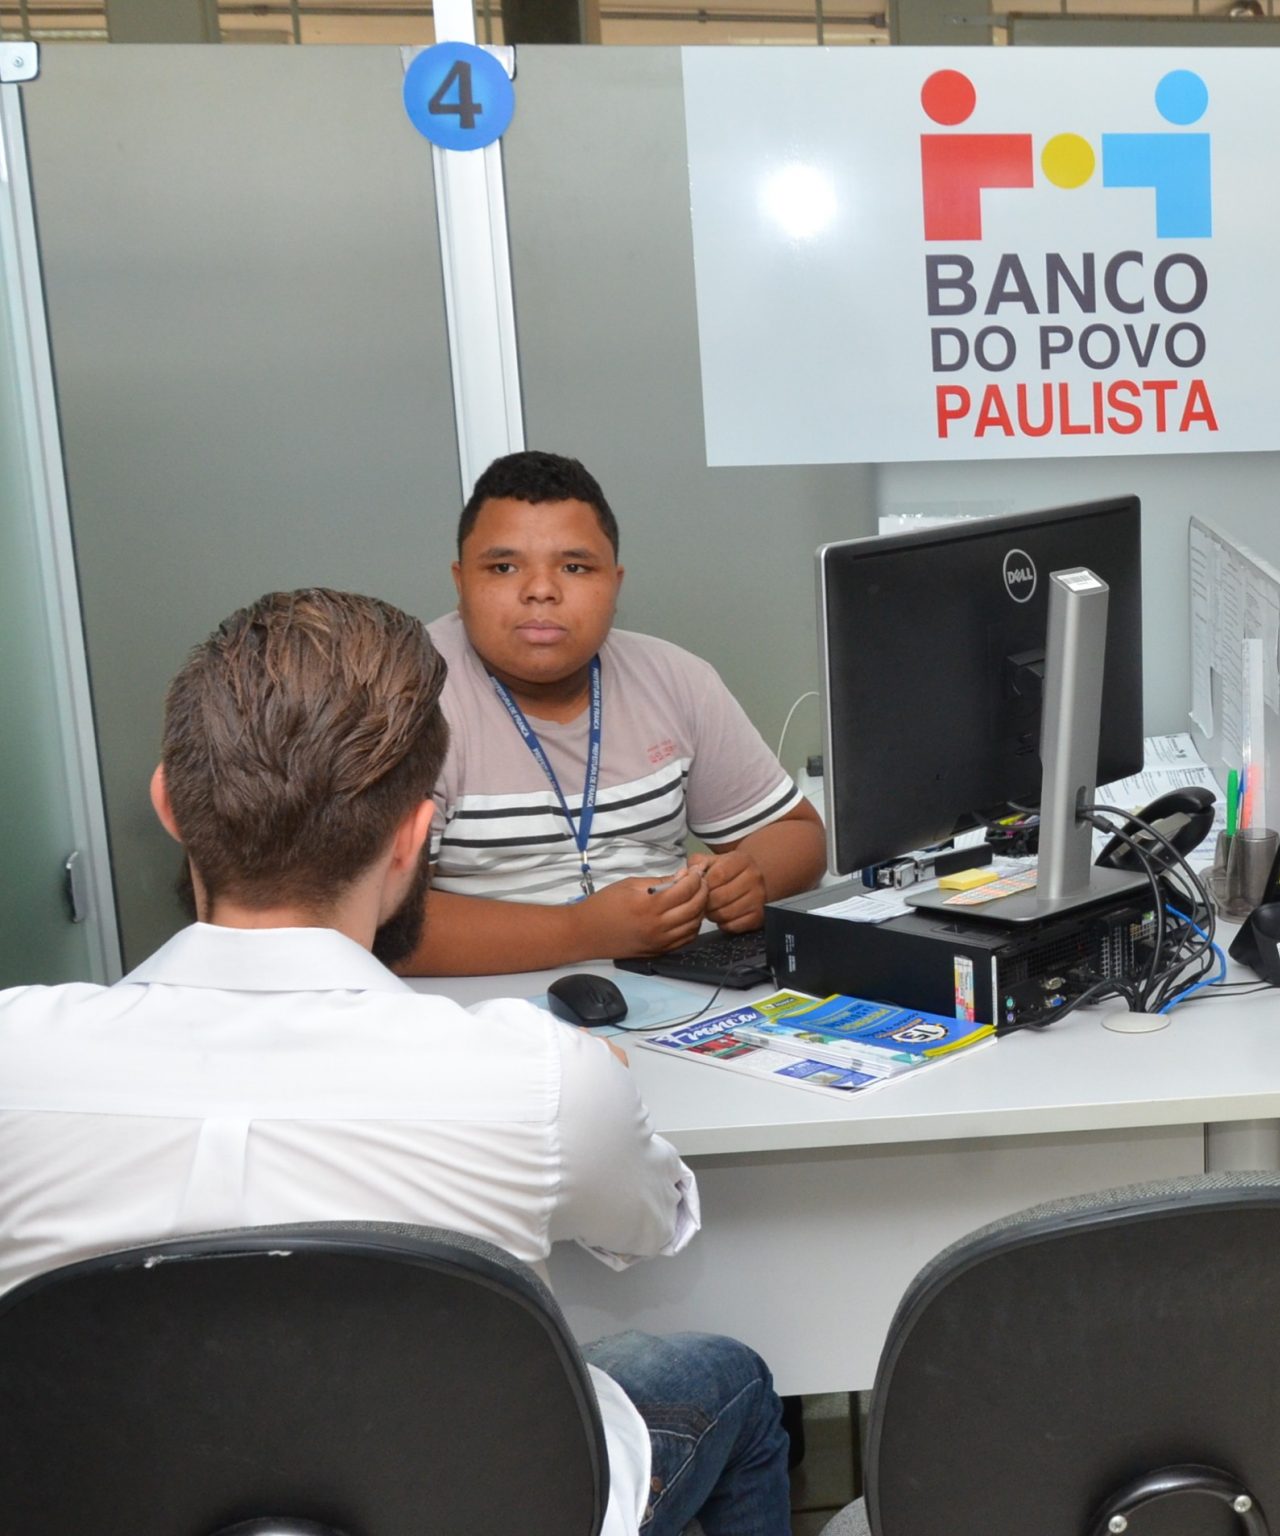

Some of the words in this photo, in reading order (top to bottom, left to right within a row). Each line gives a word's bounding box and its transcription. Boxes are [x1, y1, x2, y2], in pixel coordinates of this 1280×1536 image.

[428, 60, 482, 129] 4
[924, 250, 1208, 317] BANCO
[930, 325, 1017, 373] DO
[1039, 321, 1207, 370] POVO
[936, 379, 1219, 438] PAULISTA
[1007, 567, 1033, 585] DELL
[513, 715, 529, 738] FRANCA
[592, 708, 600, 730] FRANCA
[587, 785, 597, 808] FRANCA
